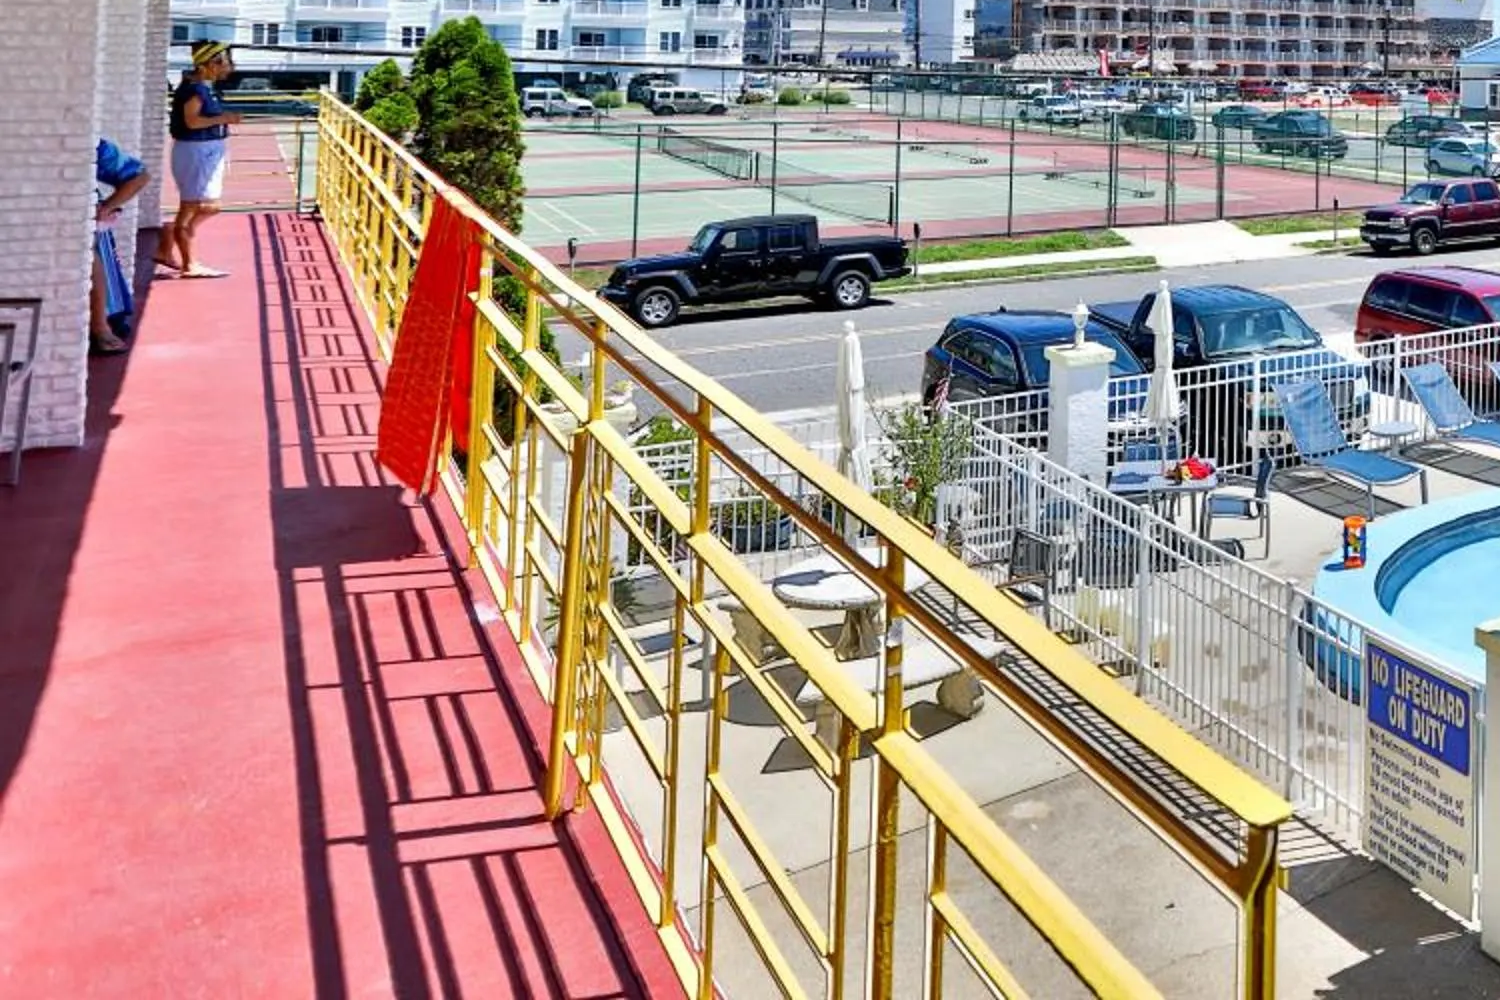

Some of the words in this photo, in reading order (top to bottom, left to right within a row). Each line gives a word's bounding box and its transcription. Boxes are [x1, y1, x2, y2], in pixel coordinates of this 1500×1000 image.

[1371, 652, 1389, 689] NO
[1394, 664, 1466, 729] LIFEGUARD
[1388, 695, 1407, 732] ON
[1411, 708, 1447, 754] DUTY
